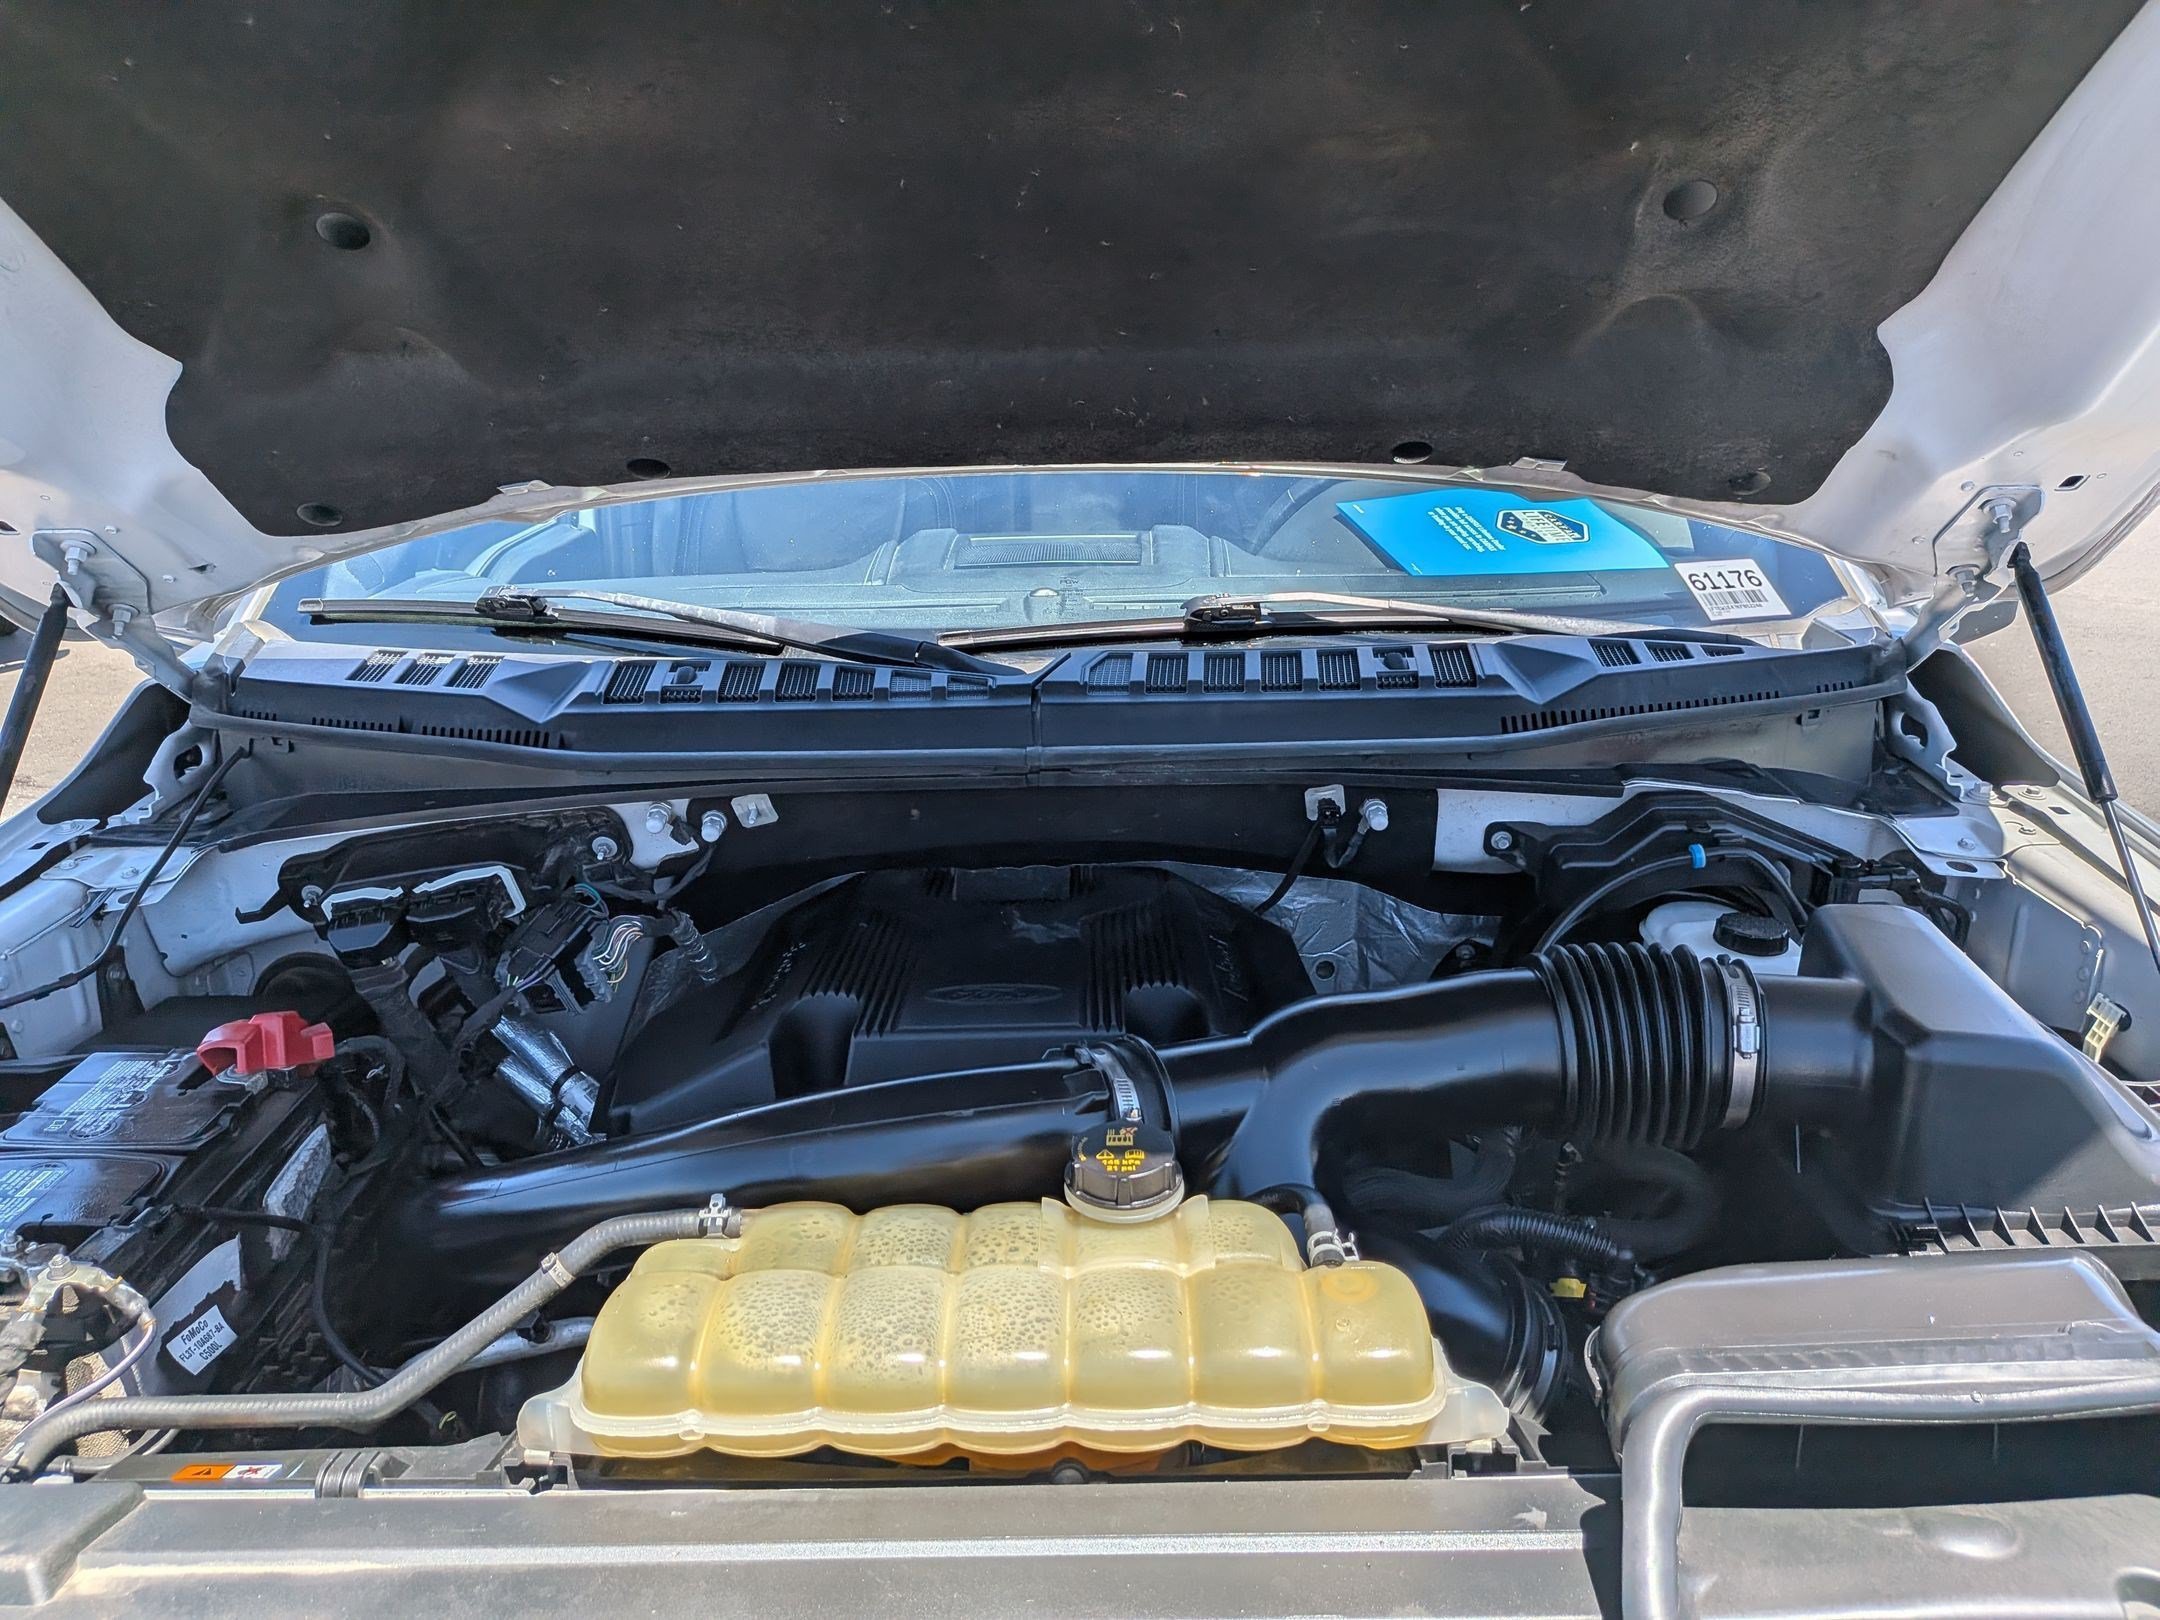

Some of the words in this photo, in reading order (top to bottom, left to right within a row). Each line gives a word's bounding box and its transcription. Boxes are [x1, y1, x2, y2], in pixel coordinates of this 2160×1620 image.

[1521, 511, 1572, 541] LIFETIME
[1688, 569, 1763, 591] 61176
[181, 1319, 209, 1345] FoMoCo
[199, 1340, 223, 1360] C500L
